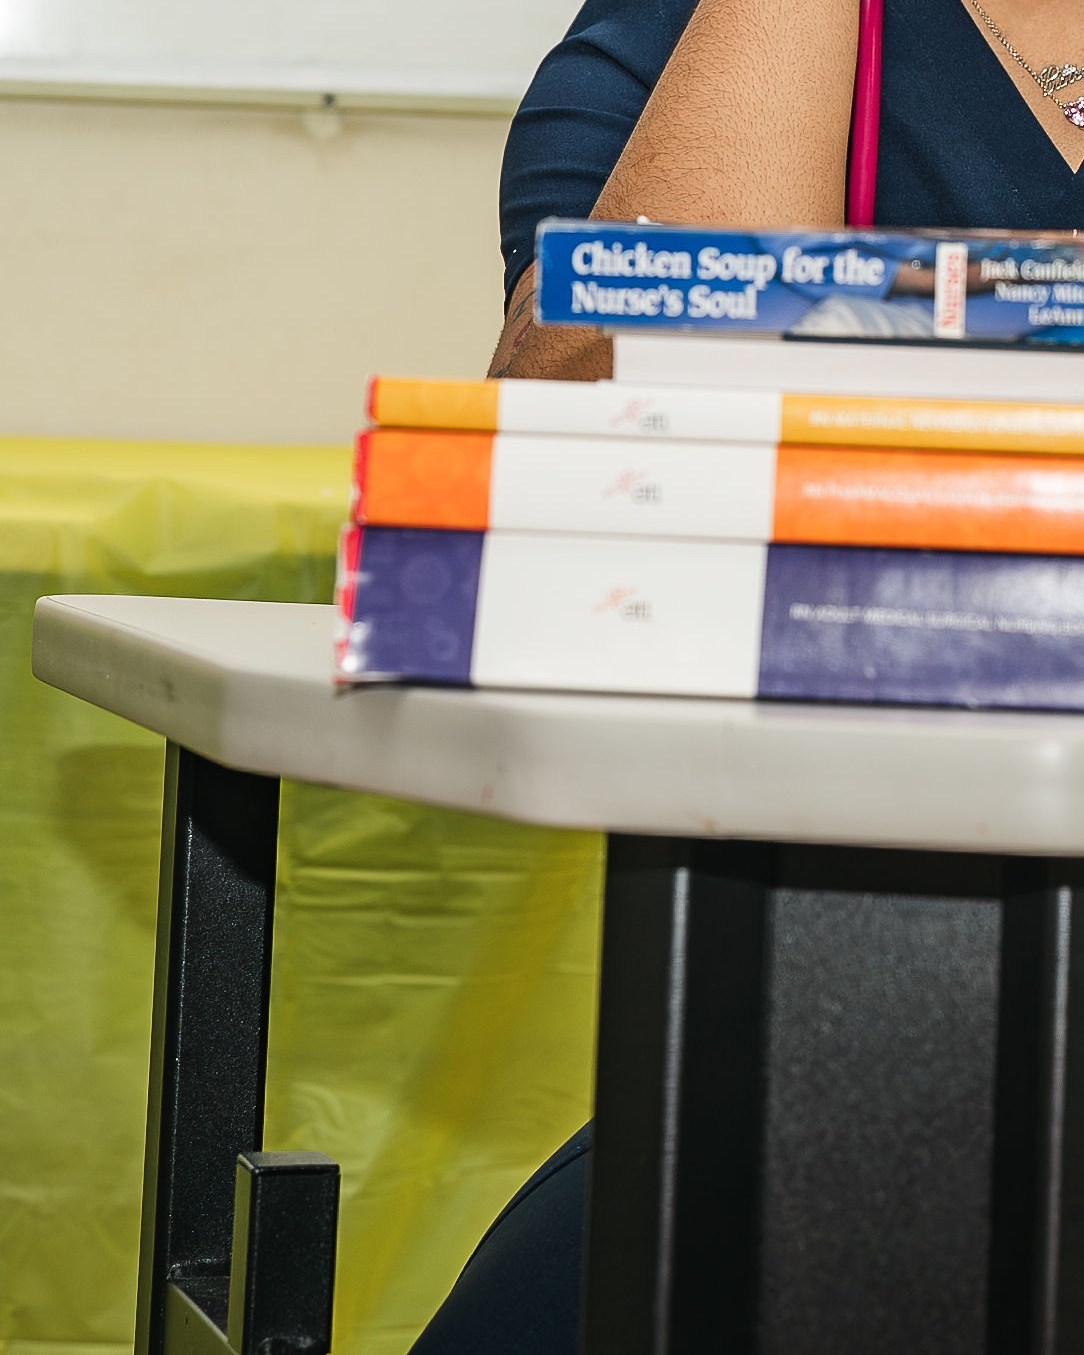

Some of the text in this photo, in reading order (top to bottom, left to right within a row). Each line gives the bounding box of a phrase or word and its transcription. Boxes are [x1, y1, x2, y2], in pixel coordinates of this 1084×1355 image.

[571, 240, 885, 290] Chicken Soup for the
[571, 281, 758, 320] Nurse's Soul
